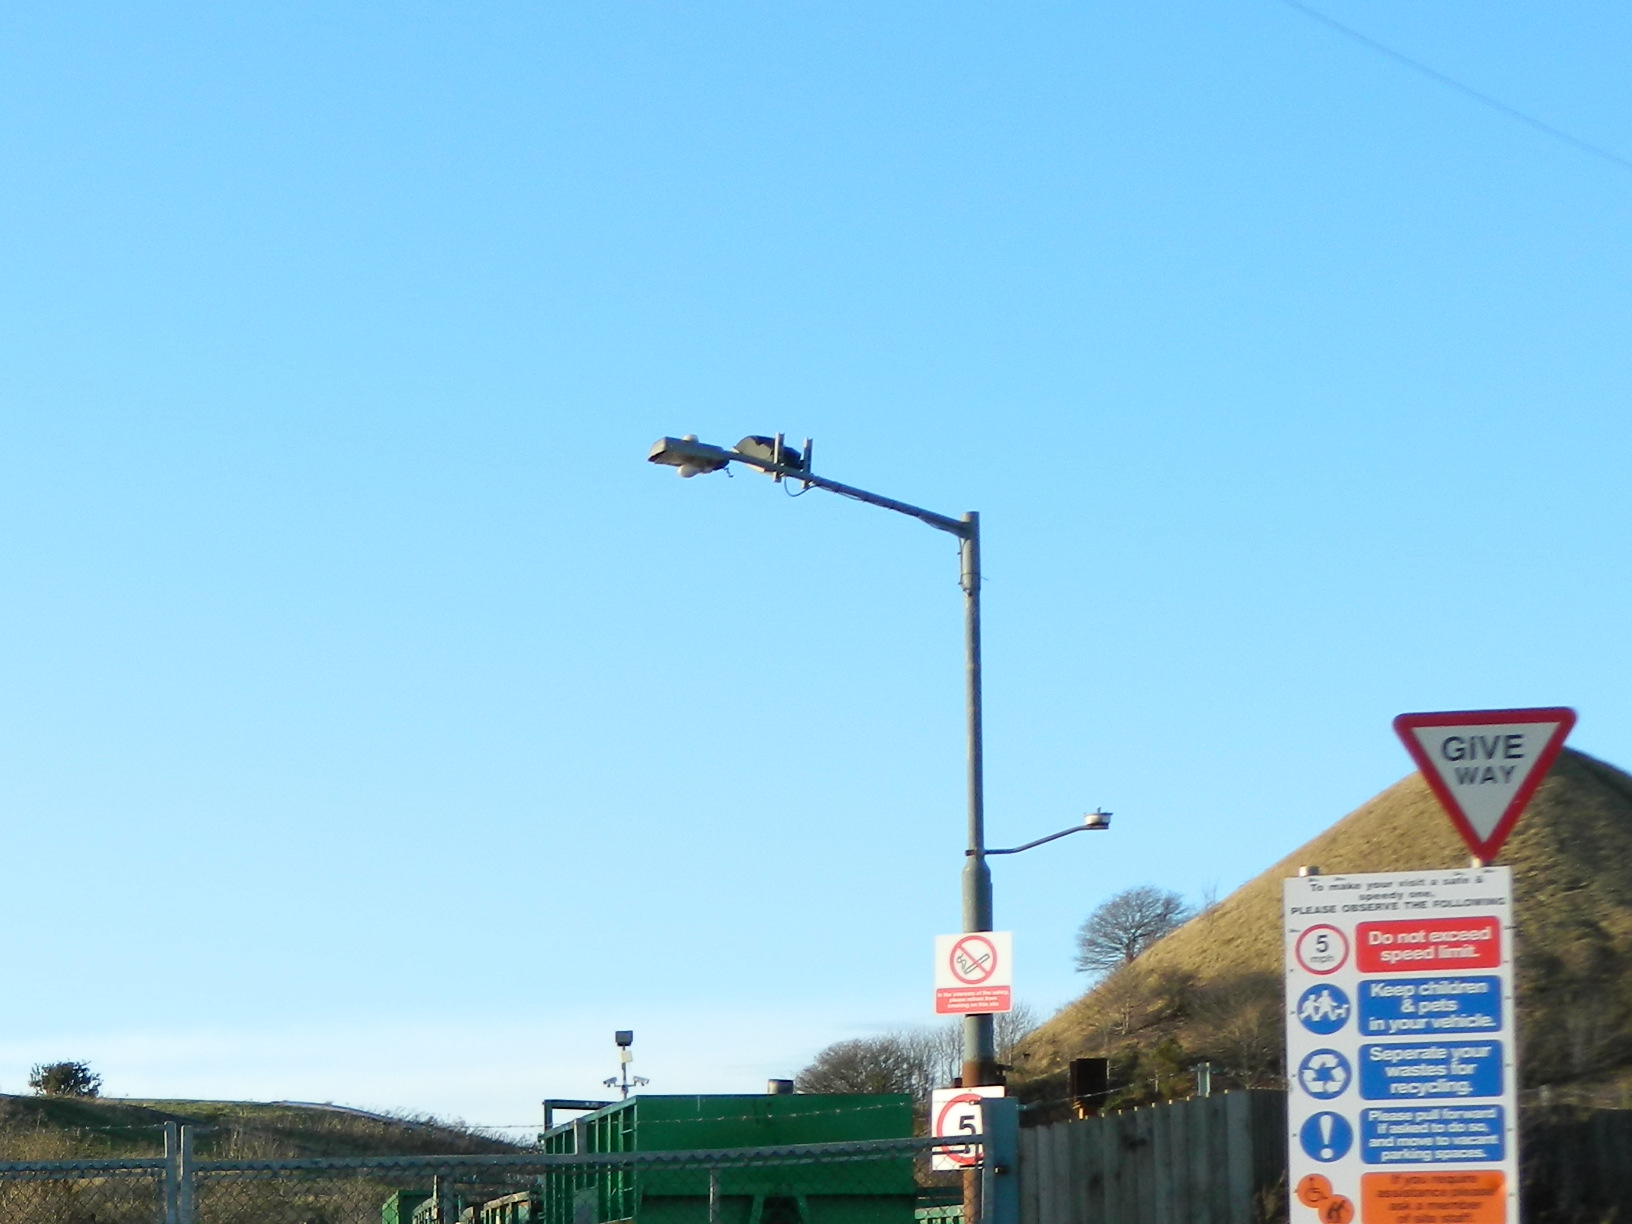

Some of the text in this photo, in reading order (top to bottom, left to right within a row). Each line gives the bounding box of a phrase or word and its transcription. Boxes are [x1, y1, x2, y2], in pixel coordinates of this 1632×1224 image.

[1441, 734, 1526, 762] GIVE
[1453, 765, 1517, 785] WAY
[1358, 890, 1404, 902] speedy
[1290, 897, 1506, 915] PLEASE OBSERVE THE FOLLOWING
[1315, 934, 1329, 954] 5
[1368, 927, 1492, 946] Do not exceed
[1310, 954, 1334, 964] mph
[1380, 946, 1435, 963] speed
[1370, 981, 1489, 999] Keep children
[1401, 999, 1458, 1015] & pets
[1369, 1017, 1385, 1031] in
[1388, 1018, 1428, 1034] your
[1450, 1047, 1492, 1060] your
[1385, 1058, 1478, 1077] wastes for
[1368, 1108, 1497, 1123] Please pull forward
[959, 1114, 976, 1143] 5
[1389, 1122, 1429, 1134] asked
[1430, 1122, 1445, 1132] to
[1448, 1121, 1465, 1132] do
[1369, 1135, 1499, 1147] and move to vacant
[1381, 1148, 1432, 1162] parking
